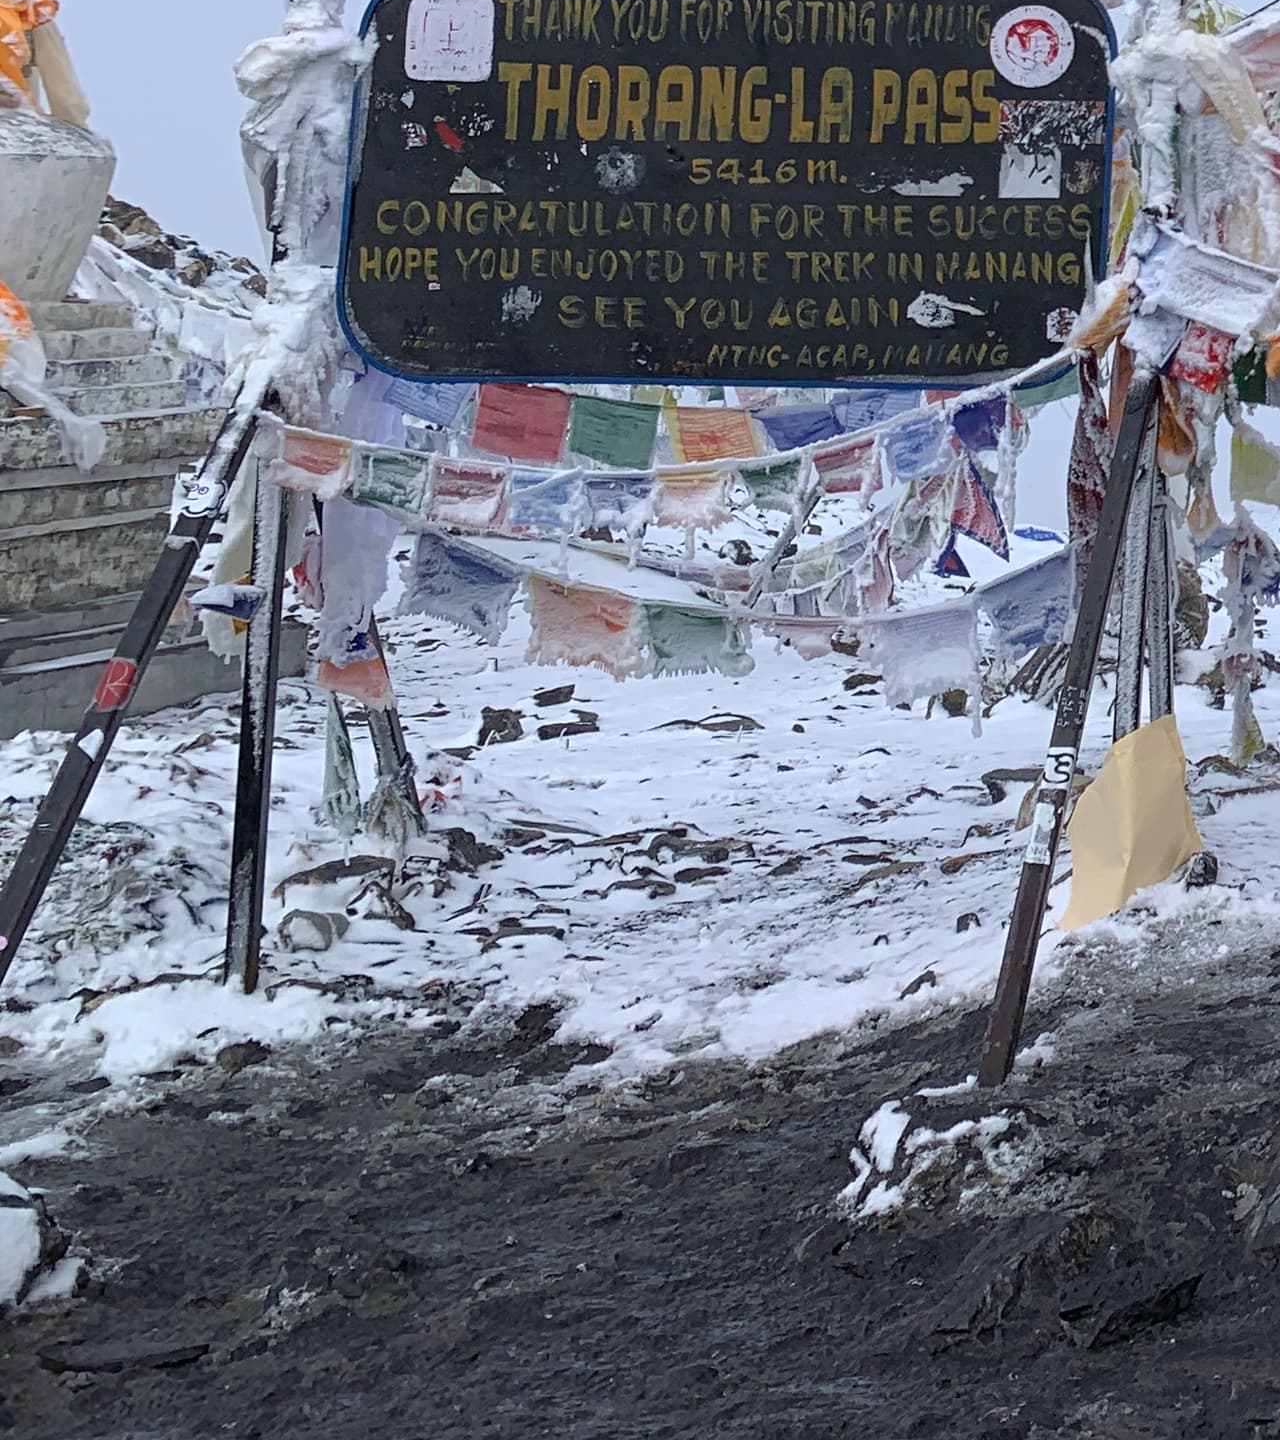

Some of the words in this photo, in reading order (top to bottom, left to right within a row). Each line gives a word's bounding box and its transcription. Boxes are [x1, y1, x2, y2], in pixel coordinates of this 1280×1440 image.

[498, 61, 855, 144] THORANG-LA
[868, 68, 1000, 145] PASS
[688, 158, 797, 187] 5416
[376, 198, 732, 239] CONGRATULATION
[749, 202, 826, 241] FOR
[837, 202, 914, 240] THE
[927, 202, 1092, 241] SUCCESS
[359, 245, 440, 283] HOPE
[455, 247, 521, 282] YOU
[530, 247, 685, 284] ENJOYED
[699, 249, 770, 283] THE
[785, 250, 875, 285] TREK
[887, 250, 924, 285] IN
[935, 250, 1082, 287] MANANG
[558, 295, 648, 329] SEE
[664, 295, 754, 331] YOU
[767, 293, 899, 332] AGAIN
